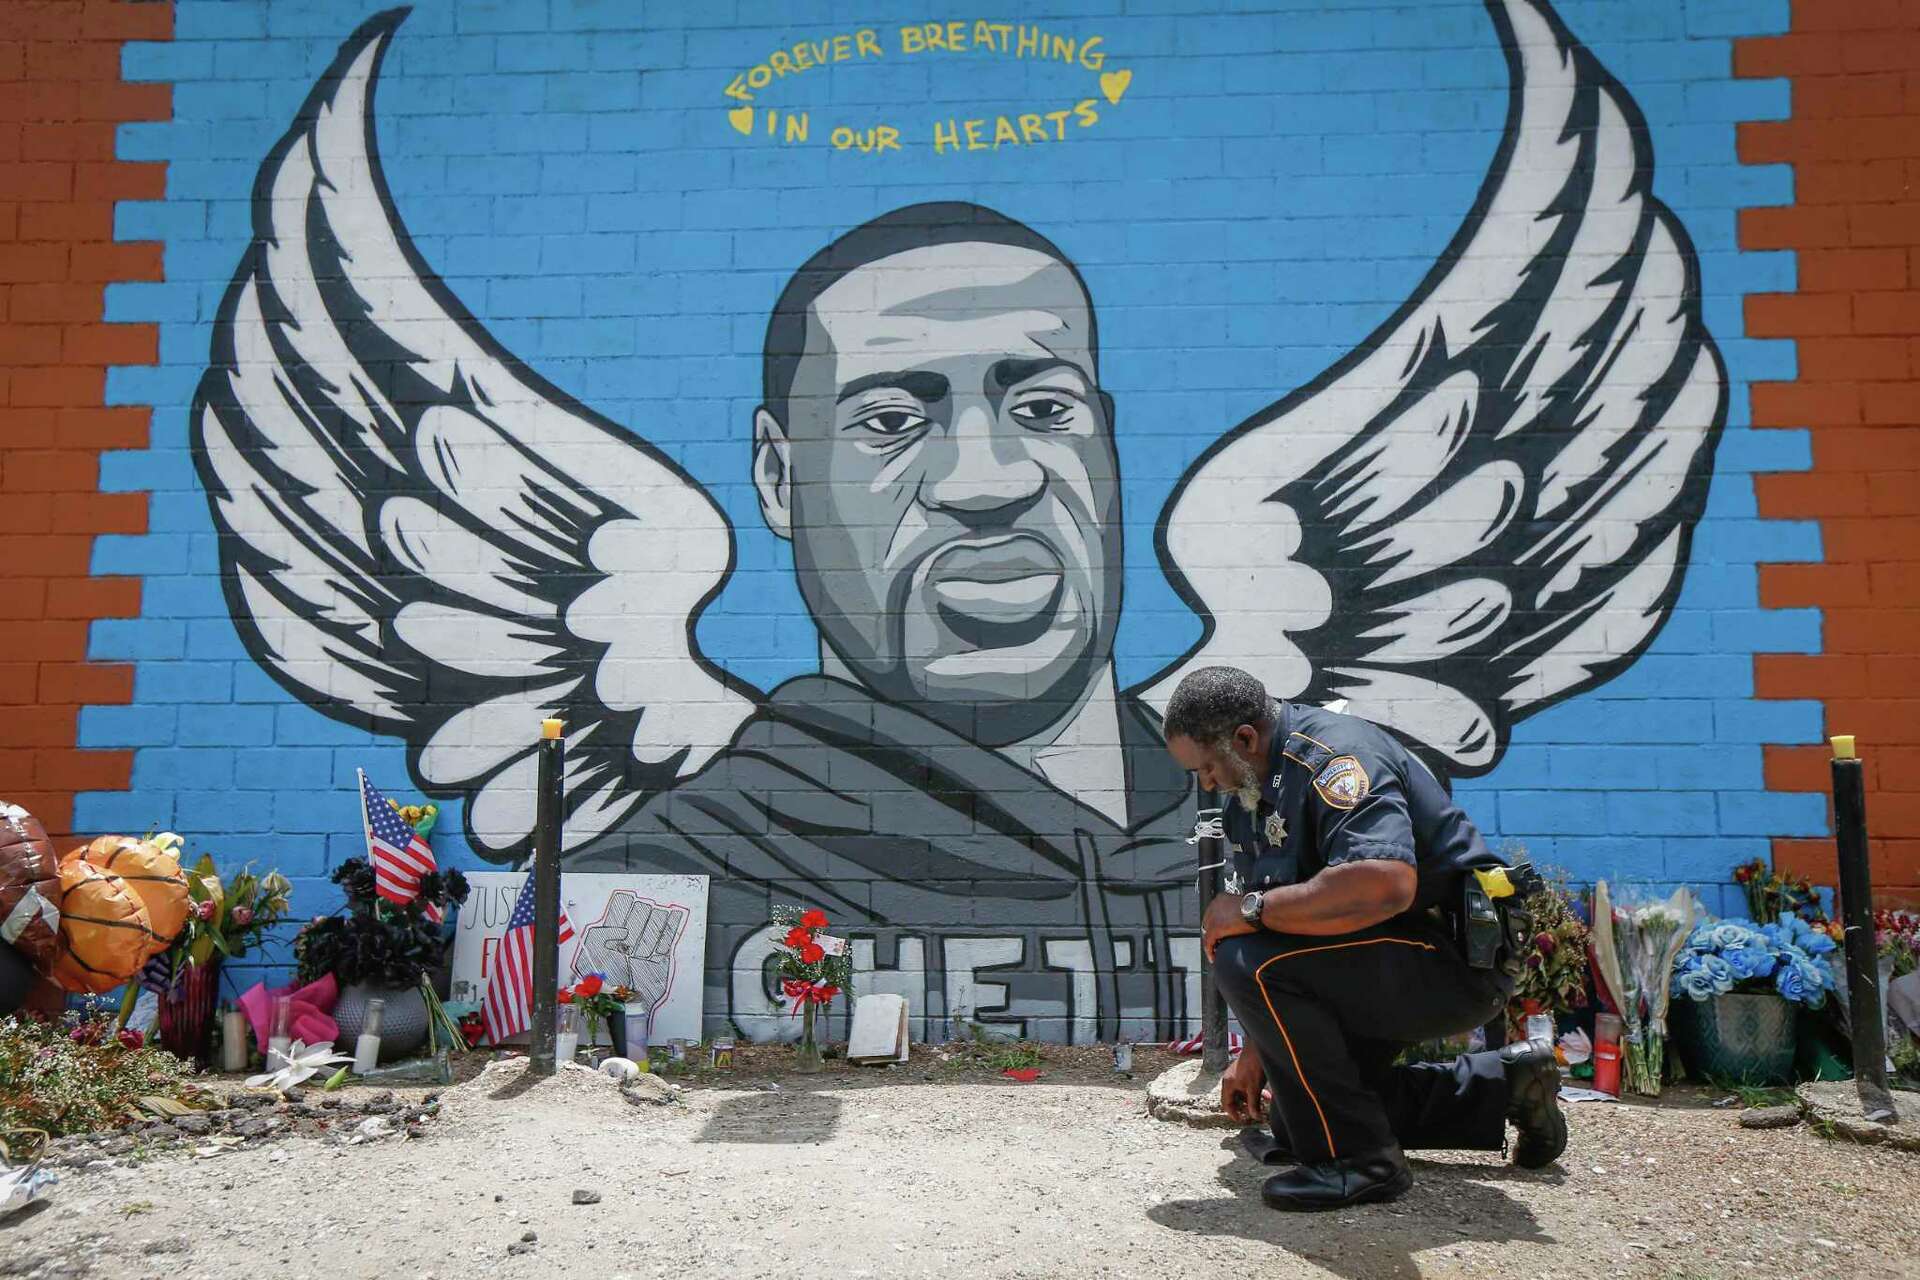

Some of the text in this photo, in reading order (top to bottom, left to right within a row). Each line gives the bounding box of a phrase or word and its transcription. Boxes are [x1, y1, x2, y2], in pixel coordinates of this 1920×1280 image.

[725, 20, 1105, 100] FOREVER BREATHING
[767, 98, 1099, 153] IN OUR HEARTS
